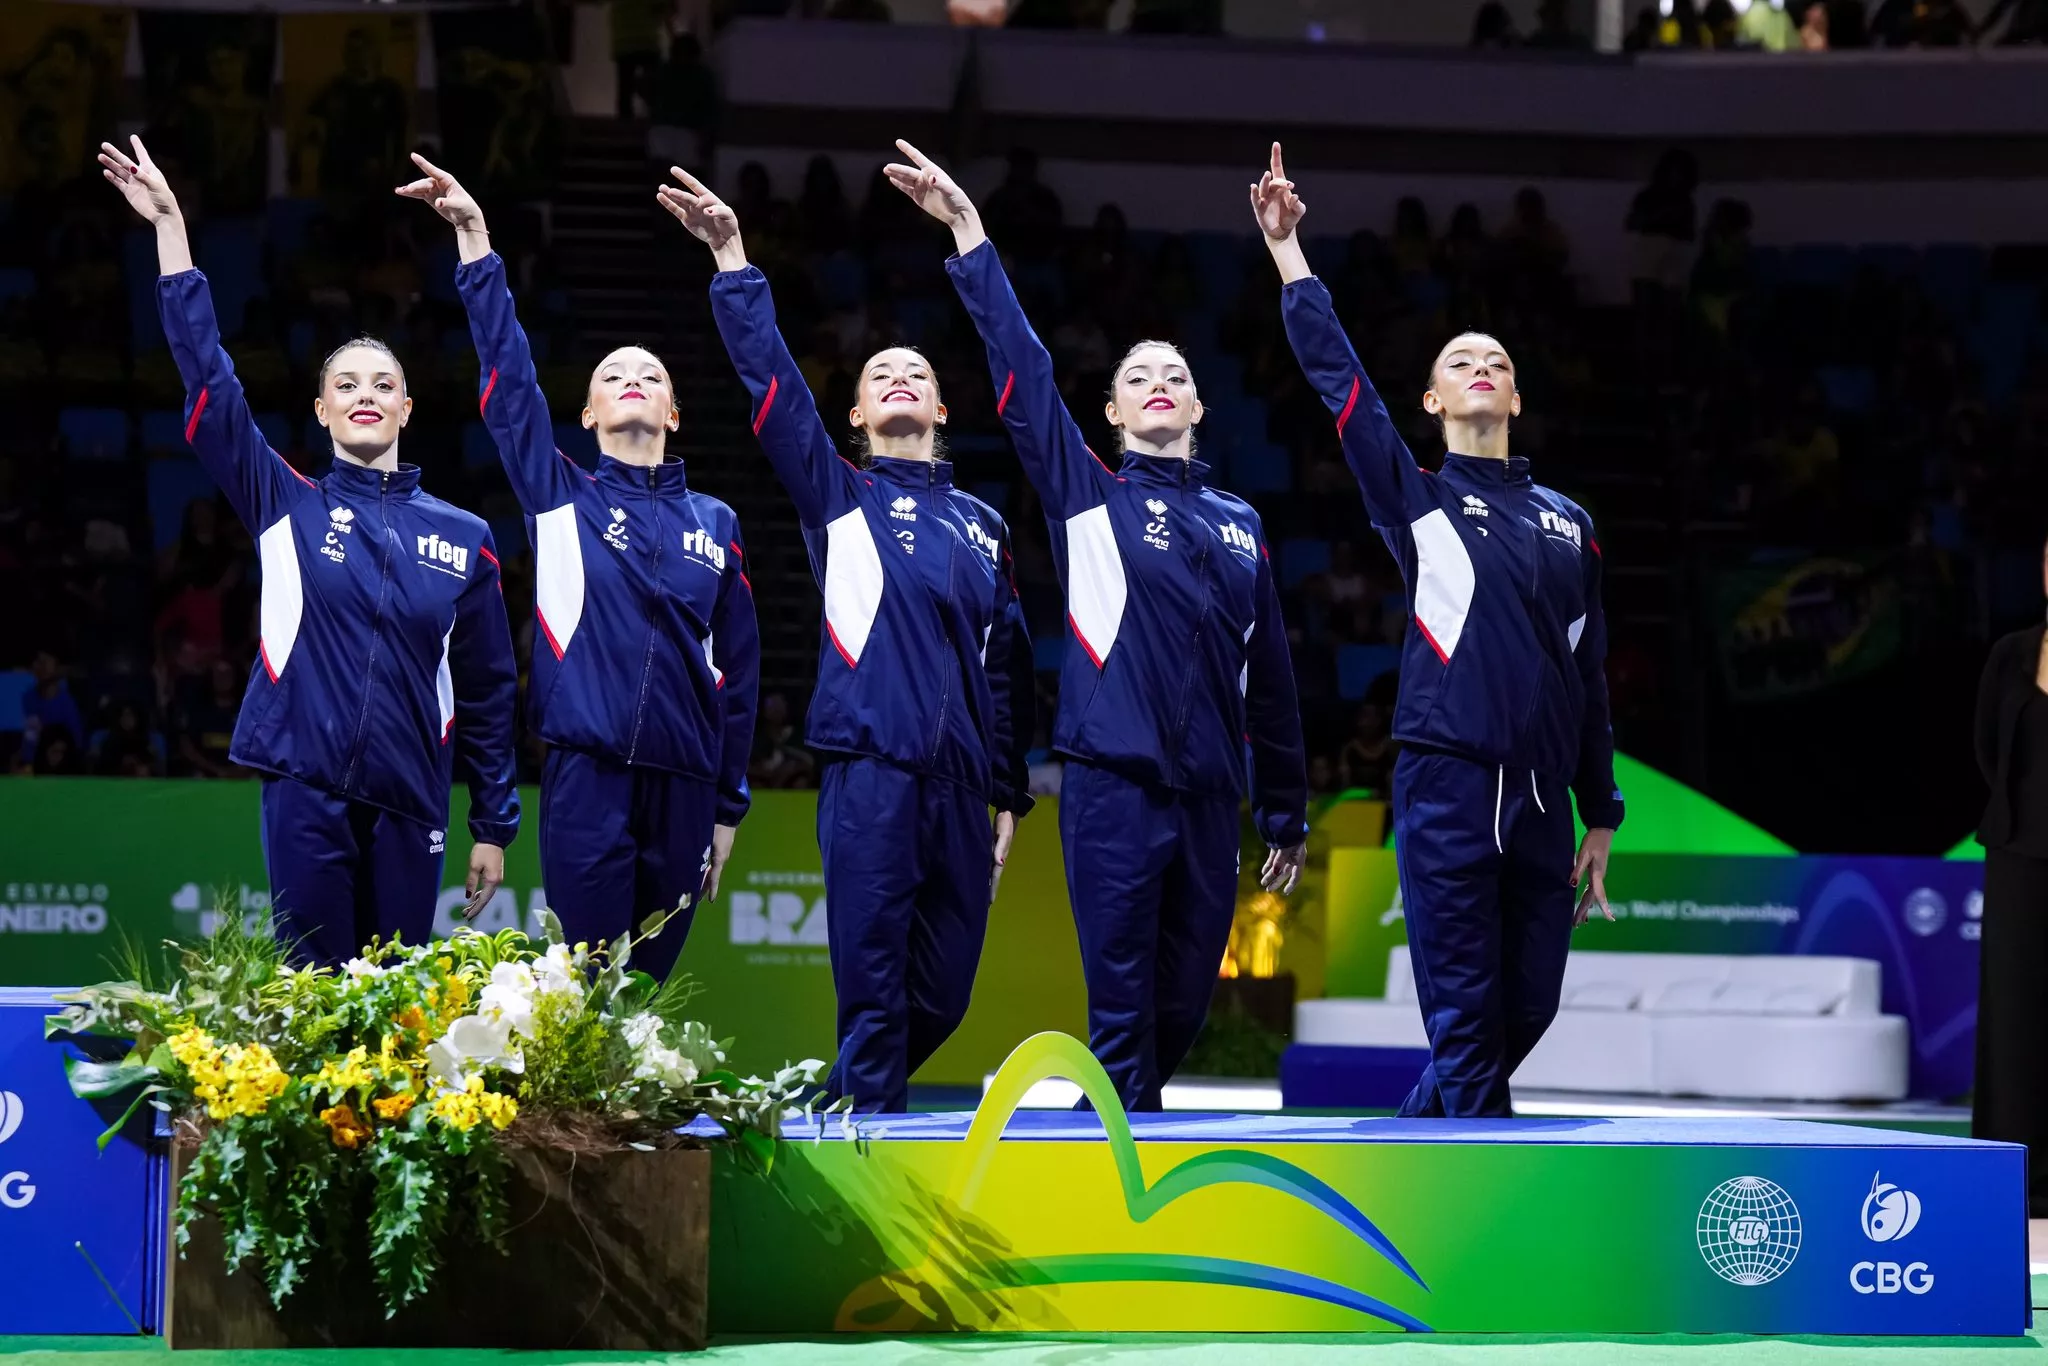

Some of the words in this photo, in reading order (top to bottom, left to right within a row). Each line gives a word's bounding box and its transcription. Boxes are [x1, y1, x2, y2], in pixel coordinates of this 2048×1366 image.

[1463, 506, 1489, 518] errea
[1538, 511, 1582, 548] rfeg
[417, 534, 468, 572] rfeg
[1850, 1261, 1935, 1295] CBG
